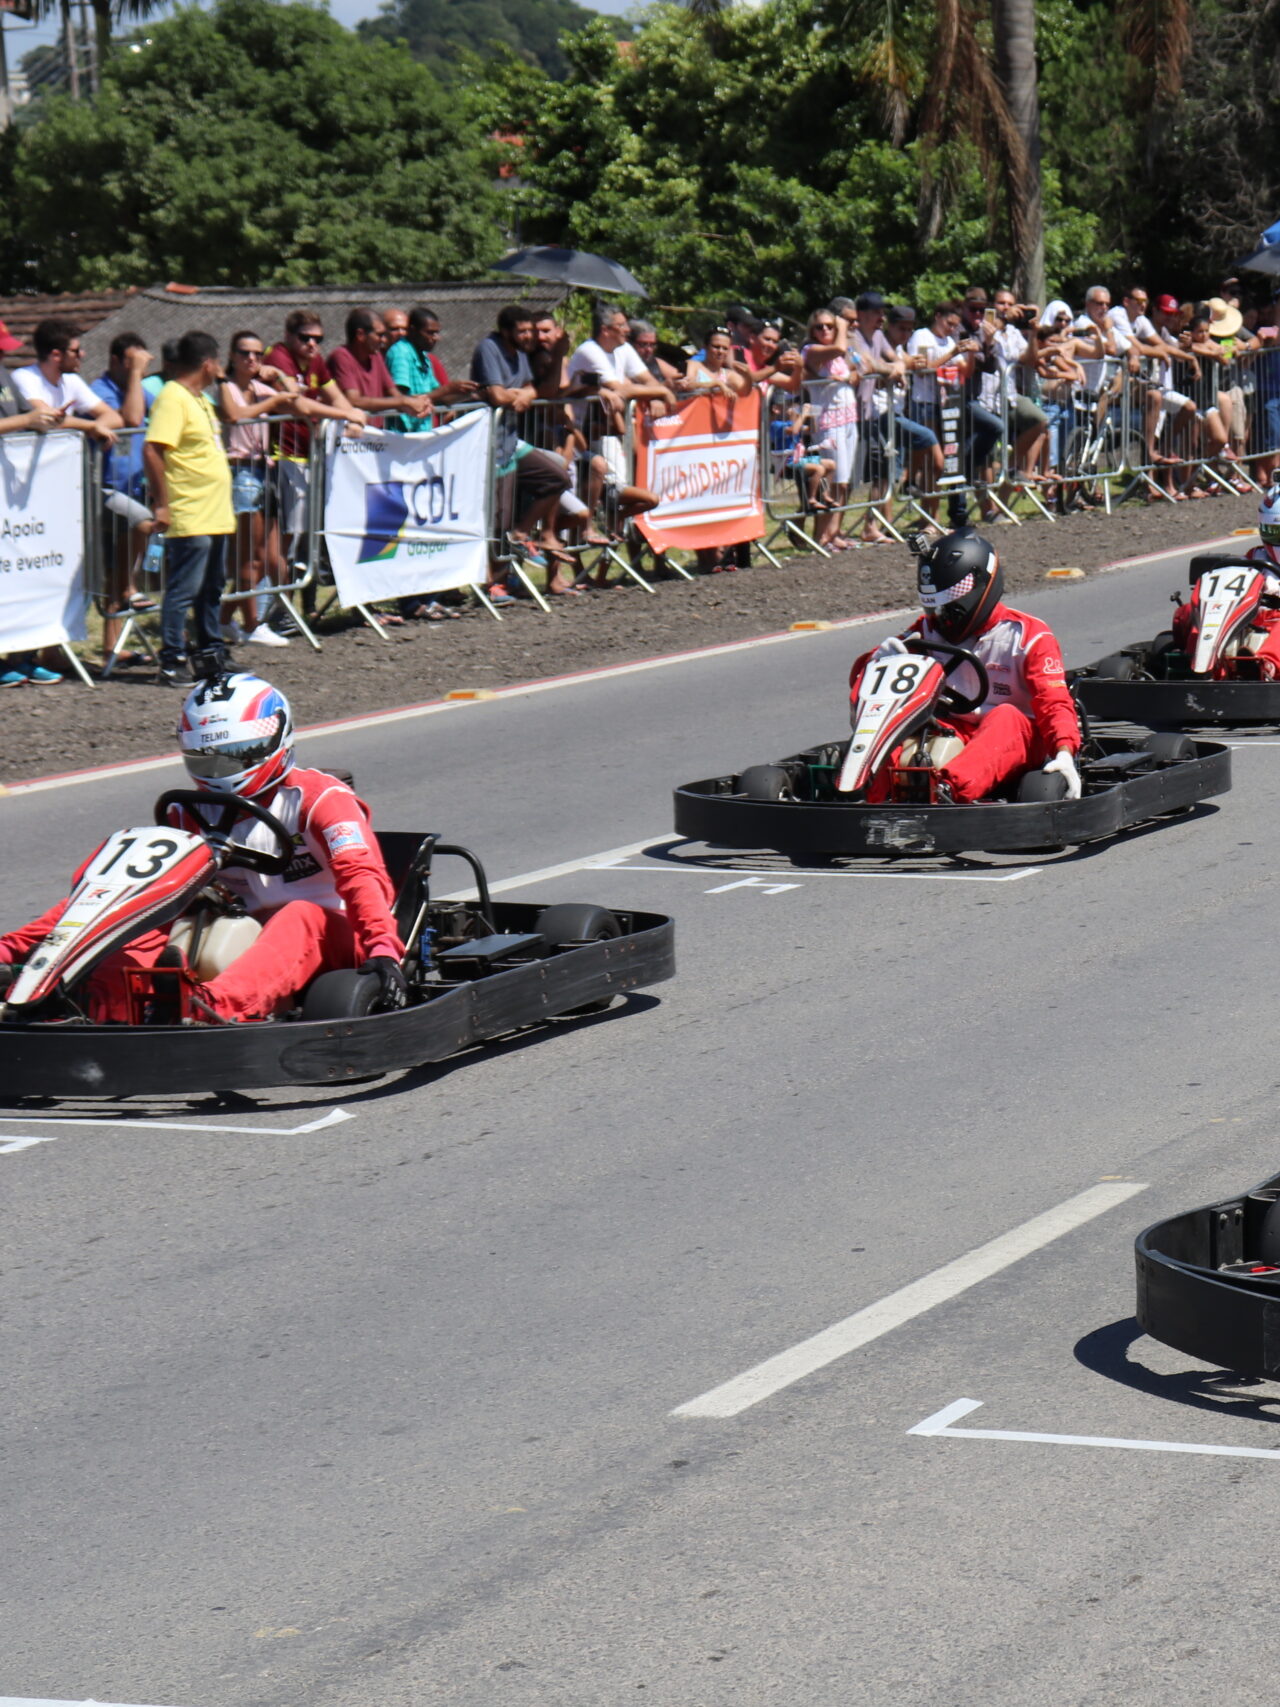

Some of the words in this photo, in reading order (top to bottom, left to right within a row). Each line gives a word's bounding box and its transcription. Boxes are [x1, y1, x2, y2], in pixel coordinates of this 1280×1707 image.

[413, 473, 459, 526] CDL
[1, 516, 45, 543] Apoia
[16, 549, 64, 571] evento
[1208, 574, 1247, 598] 14
[870, 663, 920, 695] 18
[200, 729, 230, 744] TELMO
[98, 837, 179, 880] 13
